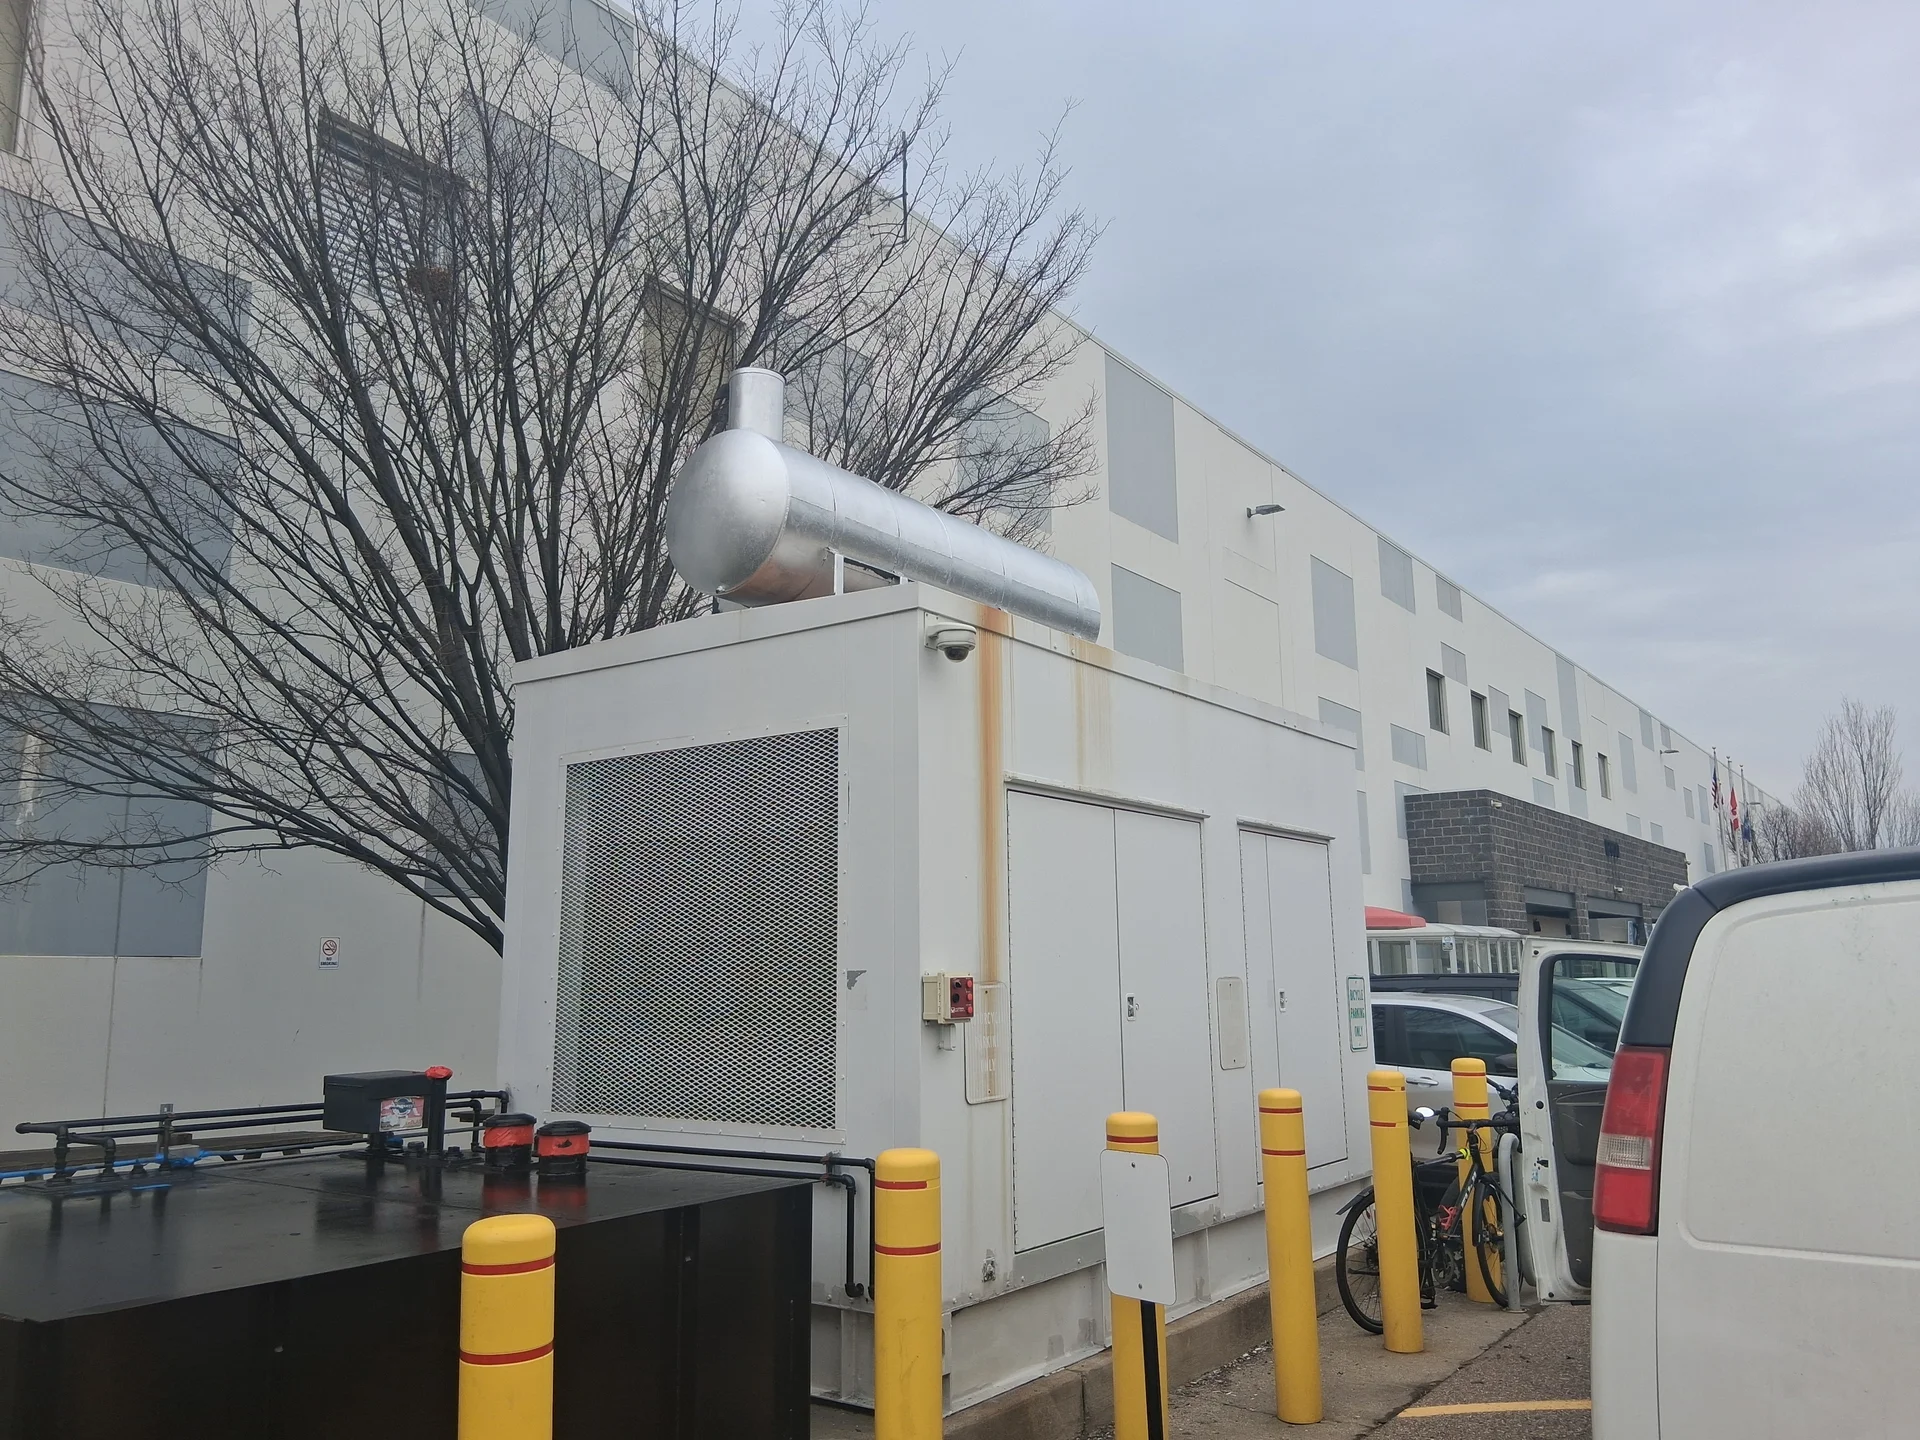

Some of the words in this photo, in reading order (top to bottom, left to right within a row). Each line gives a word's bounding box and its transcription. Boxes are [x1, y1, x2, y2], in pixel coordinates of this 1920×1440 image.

[1349, 989, 1364, 1001] BICYCLE
[1350, 1007, 1365, 1019] PARKING
[1354, 1025, 1364, 1037] ONLY
